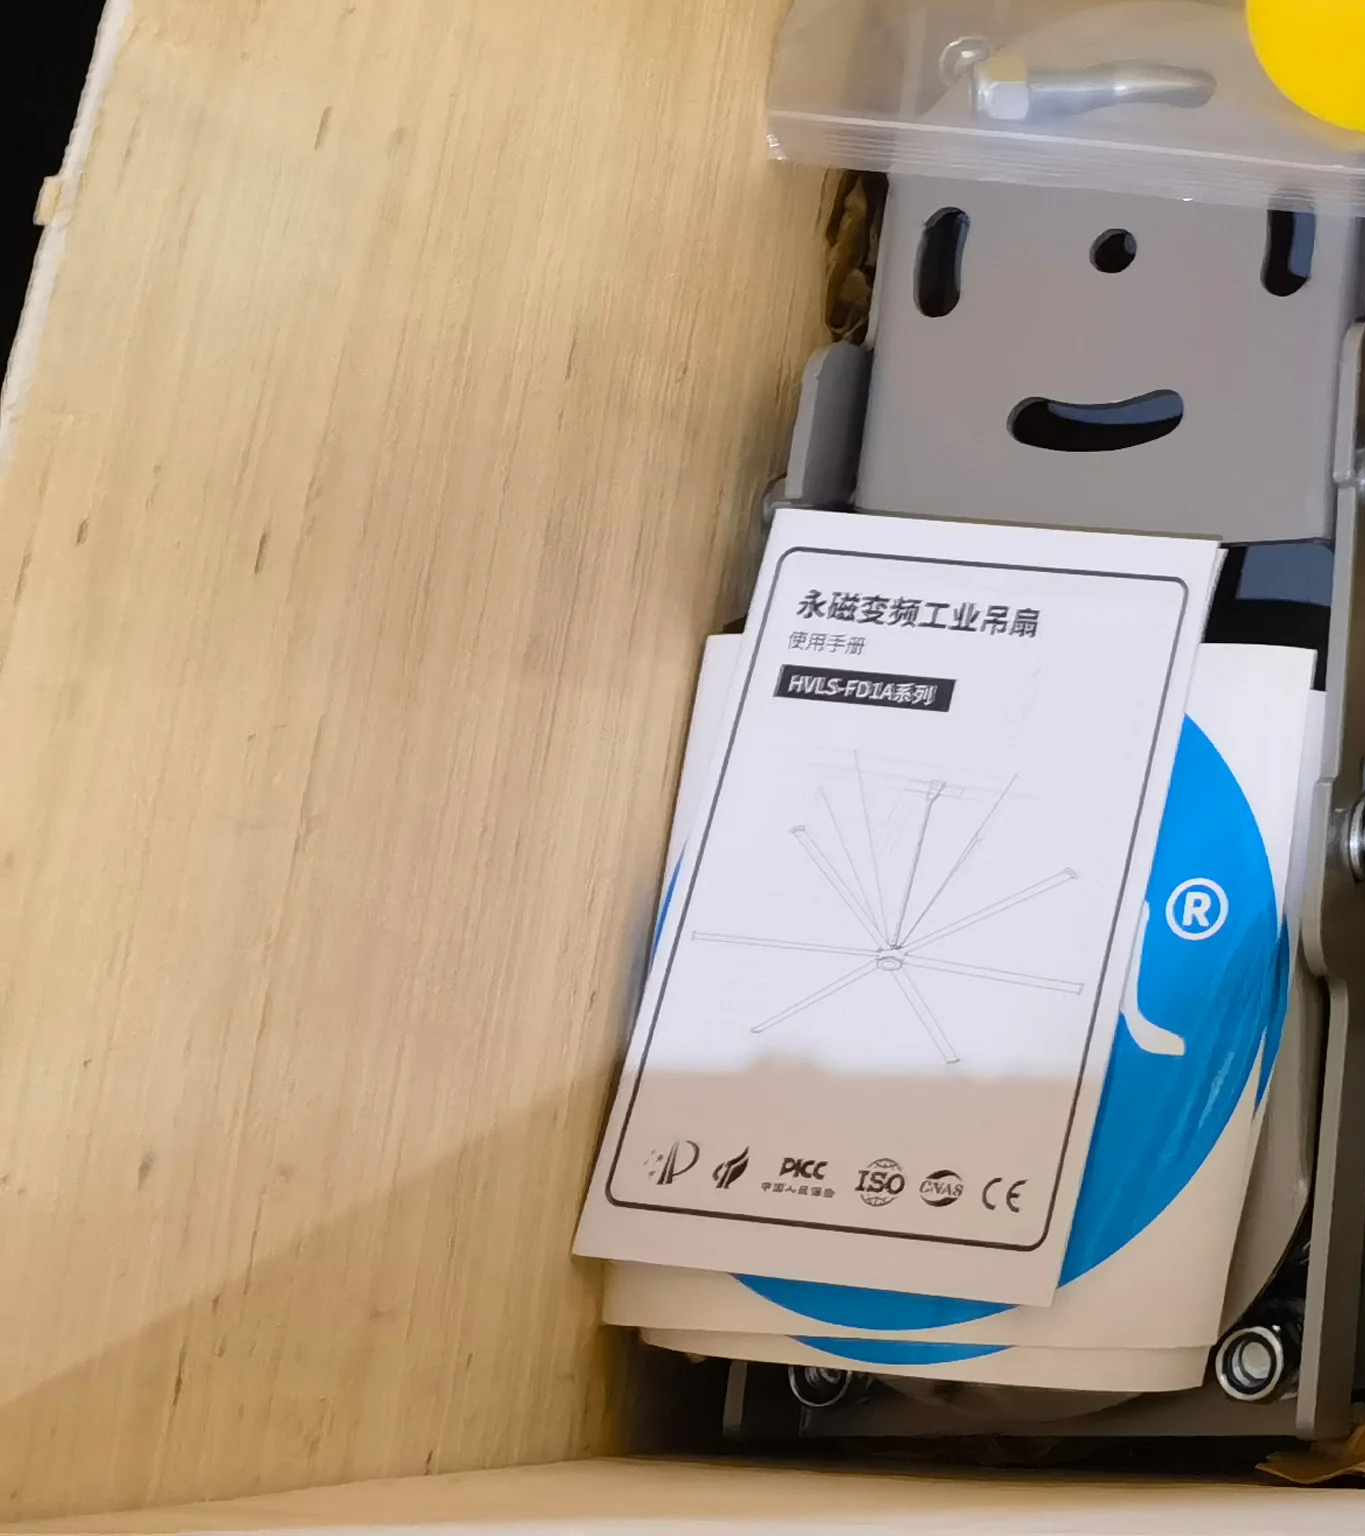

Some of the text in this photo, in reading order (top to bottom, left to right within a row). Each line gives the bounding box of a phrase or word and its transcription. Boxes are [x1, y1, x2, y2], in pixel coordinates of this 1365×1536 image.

[796, 589, 1041, 638] 永磁变频工业吊扇
[788, 631, 866, 655] 使用手册
[779, 1157, 829, 1180] PICC
[854, 1169, 906, 1195] ISO
[919, 1180, 965, 1198] CNAS
[981, 1177, 1028, 1213] CE
